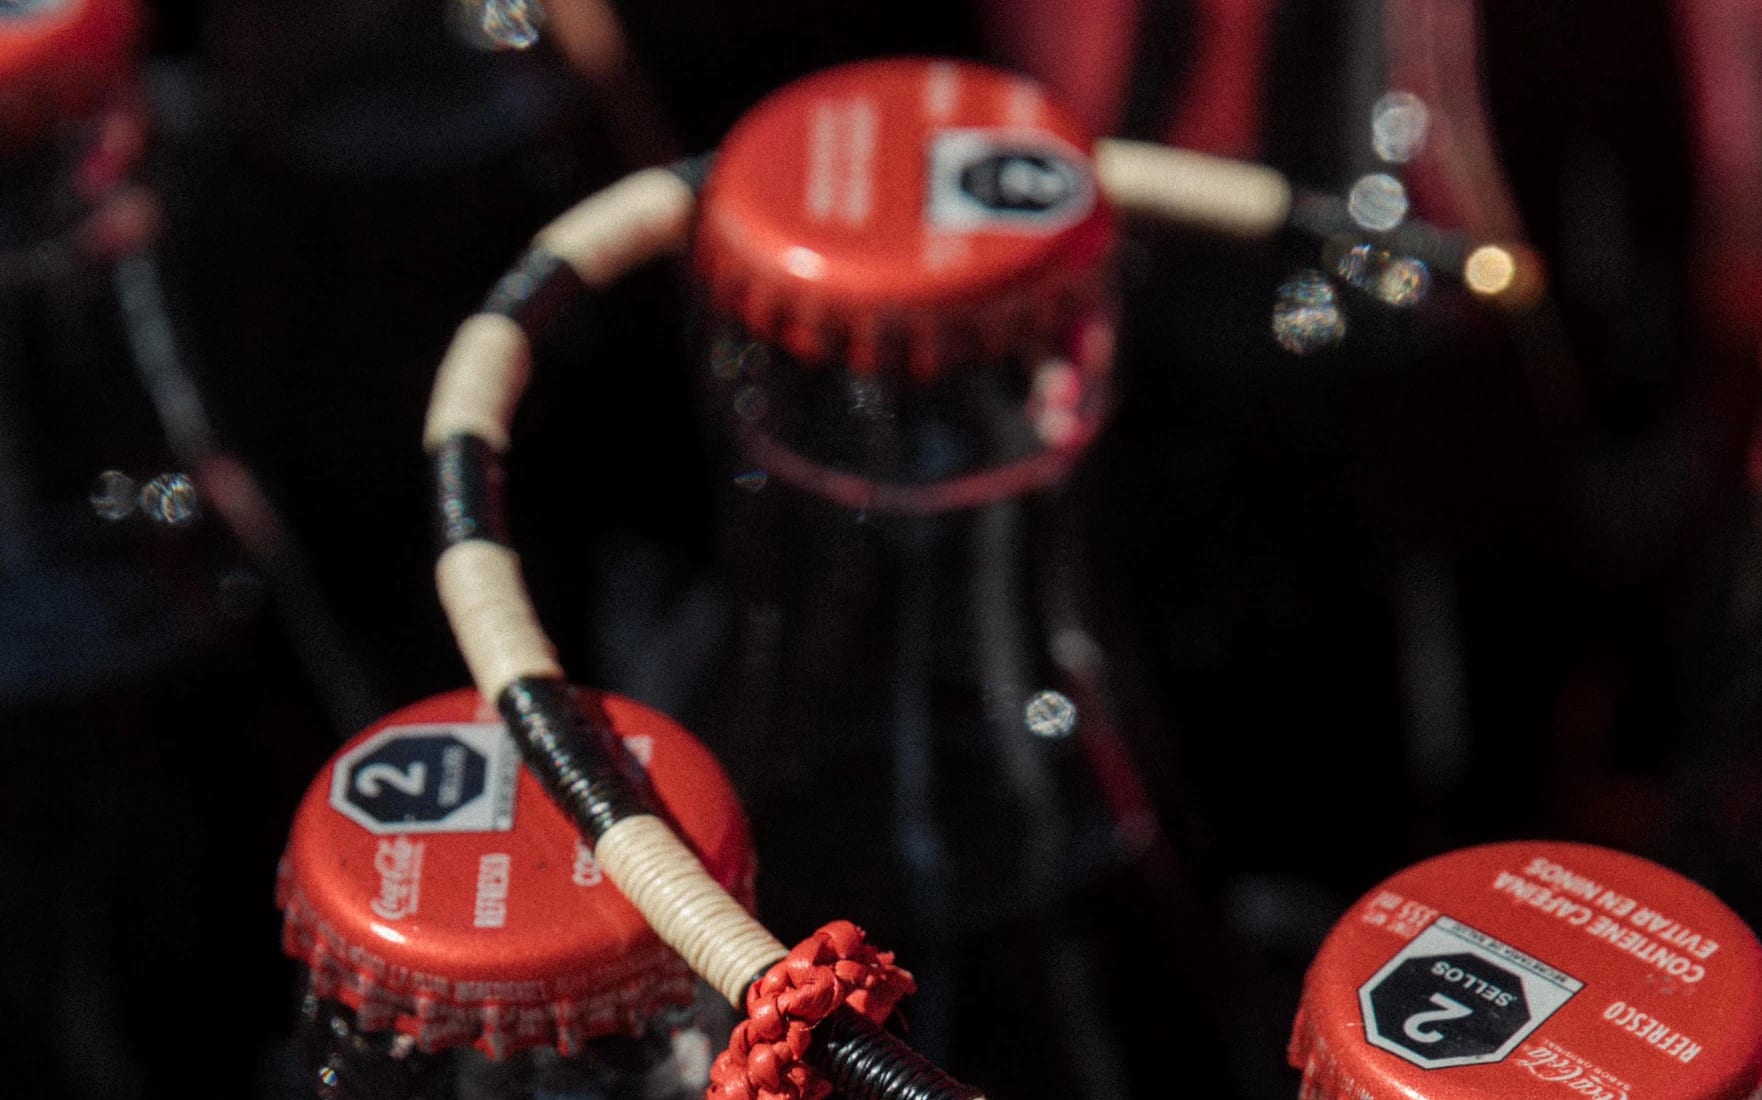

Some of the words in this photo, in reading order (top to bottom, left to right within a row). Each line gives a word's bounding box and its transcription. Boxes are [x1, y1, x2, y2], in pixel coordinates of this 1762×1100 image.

[355, 760, 427, 798] 2
[1598, 891, 1637, 916] EN
[1588, 915, 1705, 983] CONTIENE
[1631, 907, 1719, 959] EVITAR
[1431, 960, 1512, 1007] SELLOS
[1403, 992, 1473, 1043] 2
[1603, 1001, 1702, 1063] REFRESCO
